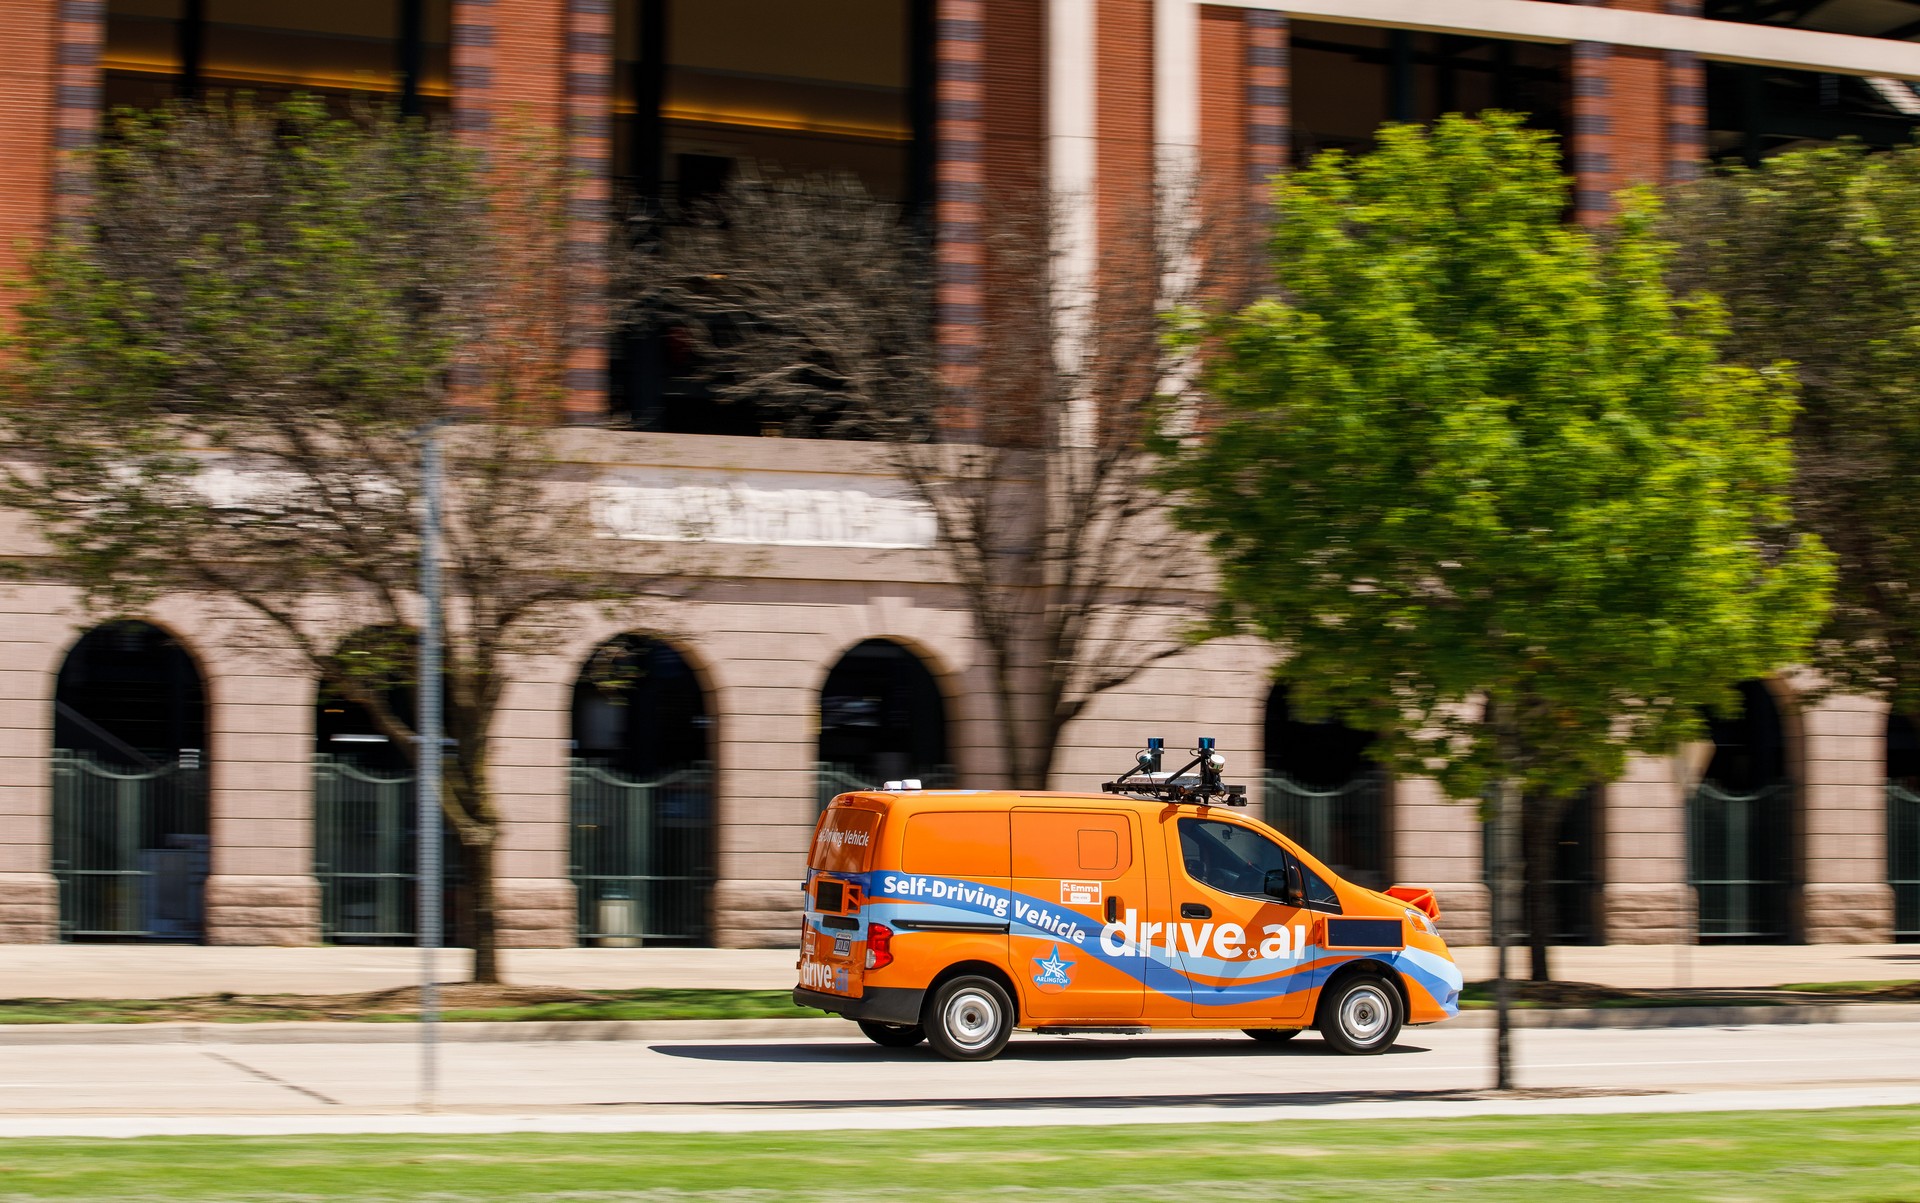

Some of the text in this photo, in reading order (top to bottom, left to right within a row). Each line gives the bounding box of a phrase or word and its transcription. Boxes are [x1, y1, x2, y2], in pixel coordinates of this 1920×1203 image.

[844, 830, 870, 847] Vehicle
[1070, 884, 1099, 893] Emma
[884, 876, 1086, 944] Self-Driving Vehicle
[1100, 908, 1306, 960] drive.ai
[1036, 976, 1068, 984] ARLINGTON
